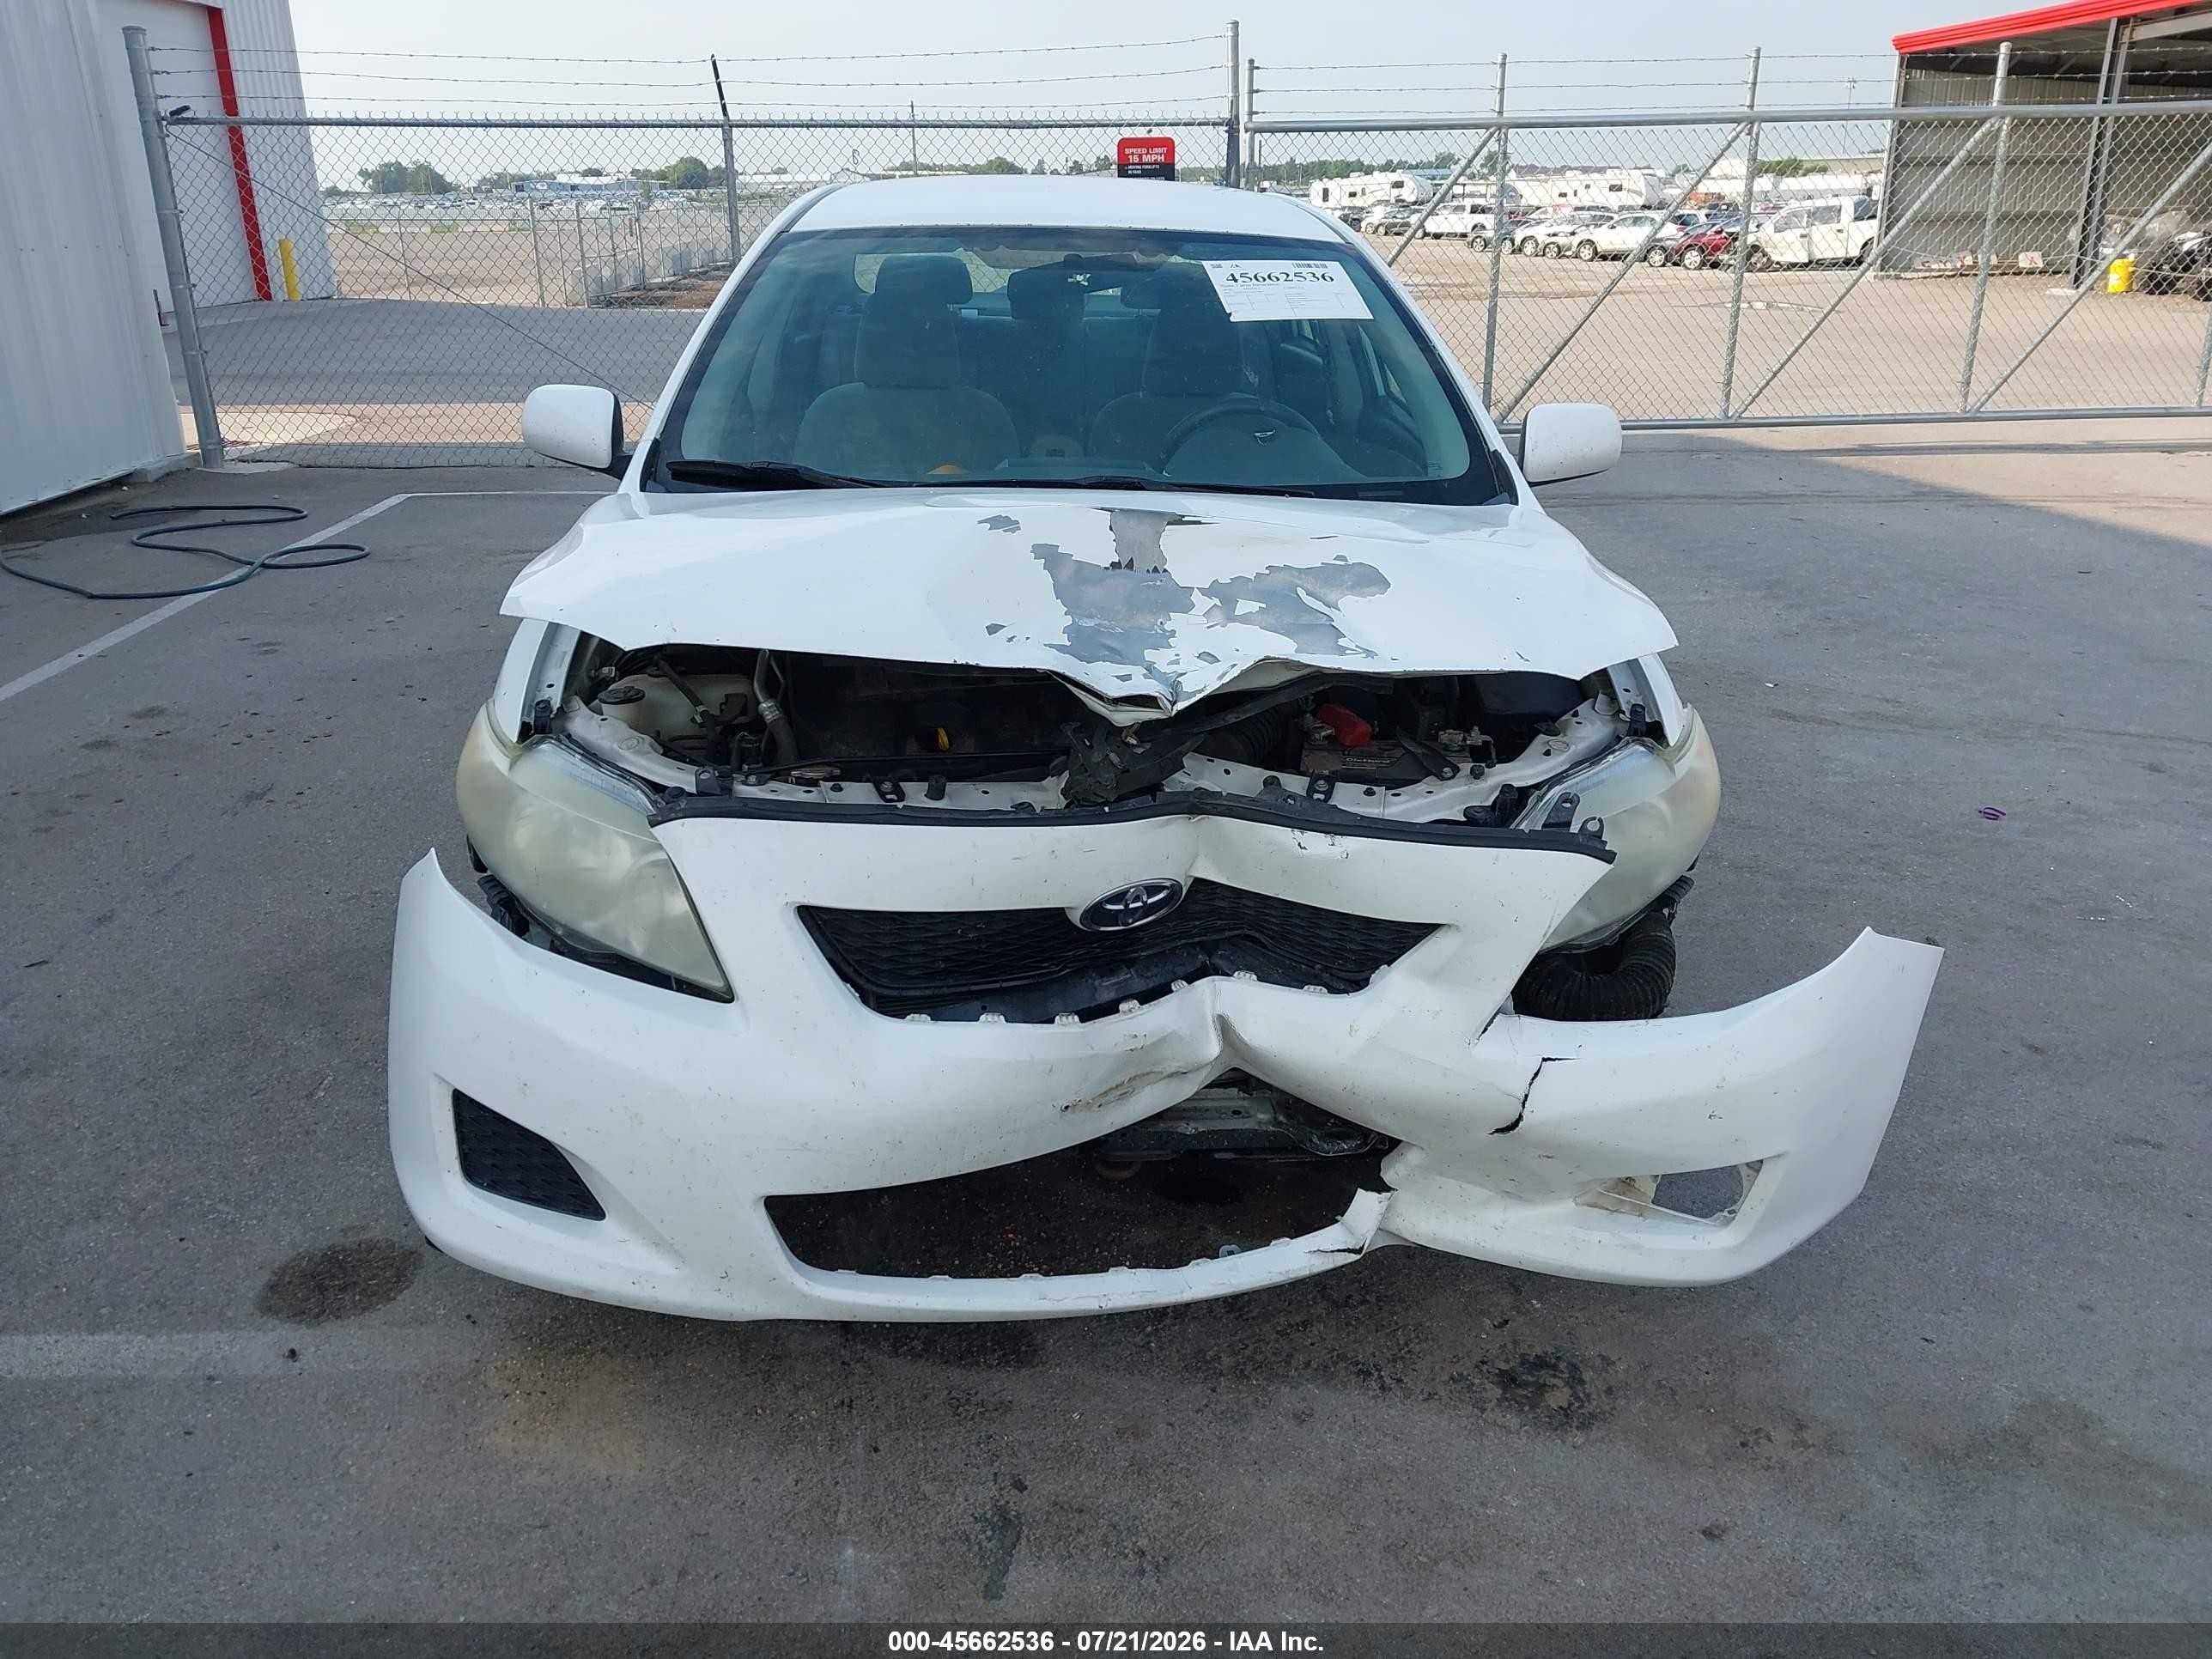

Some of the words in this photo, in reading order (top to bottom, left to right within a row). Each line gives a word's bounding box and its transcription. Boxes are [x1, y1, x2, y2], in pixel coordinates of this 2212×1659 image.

[1127, 155, 1139, 163] 15
[1142, 154, 1164, 162] MPH
[1225, 271, 1334, 283] 45662536
